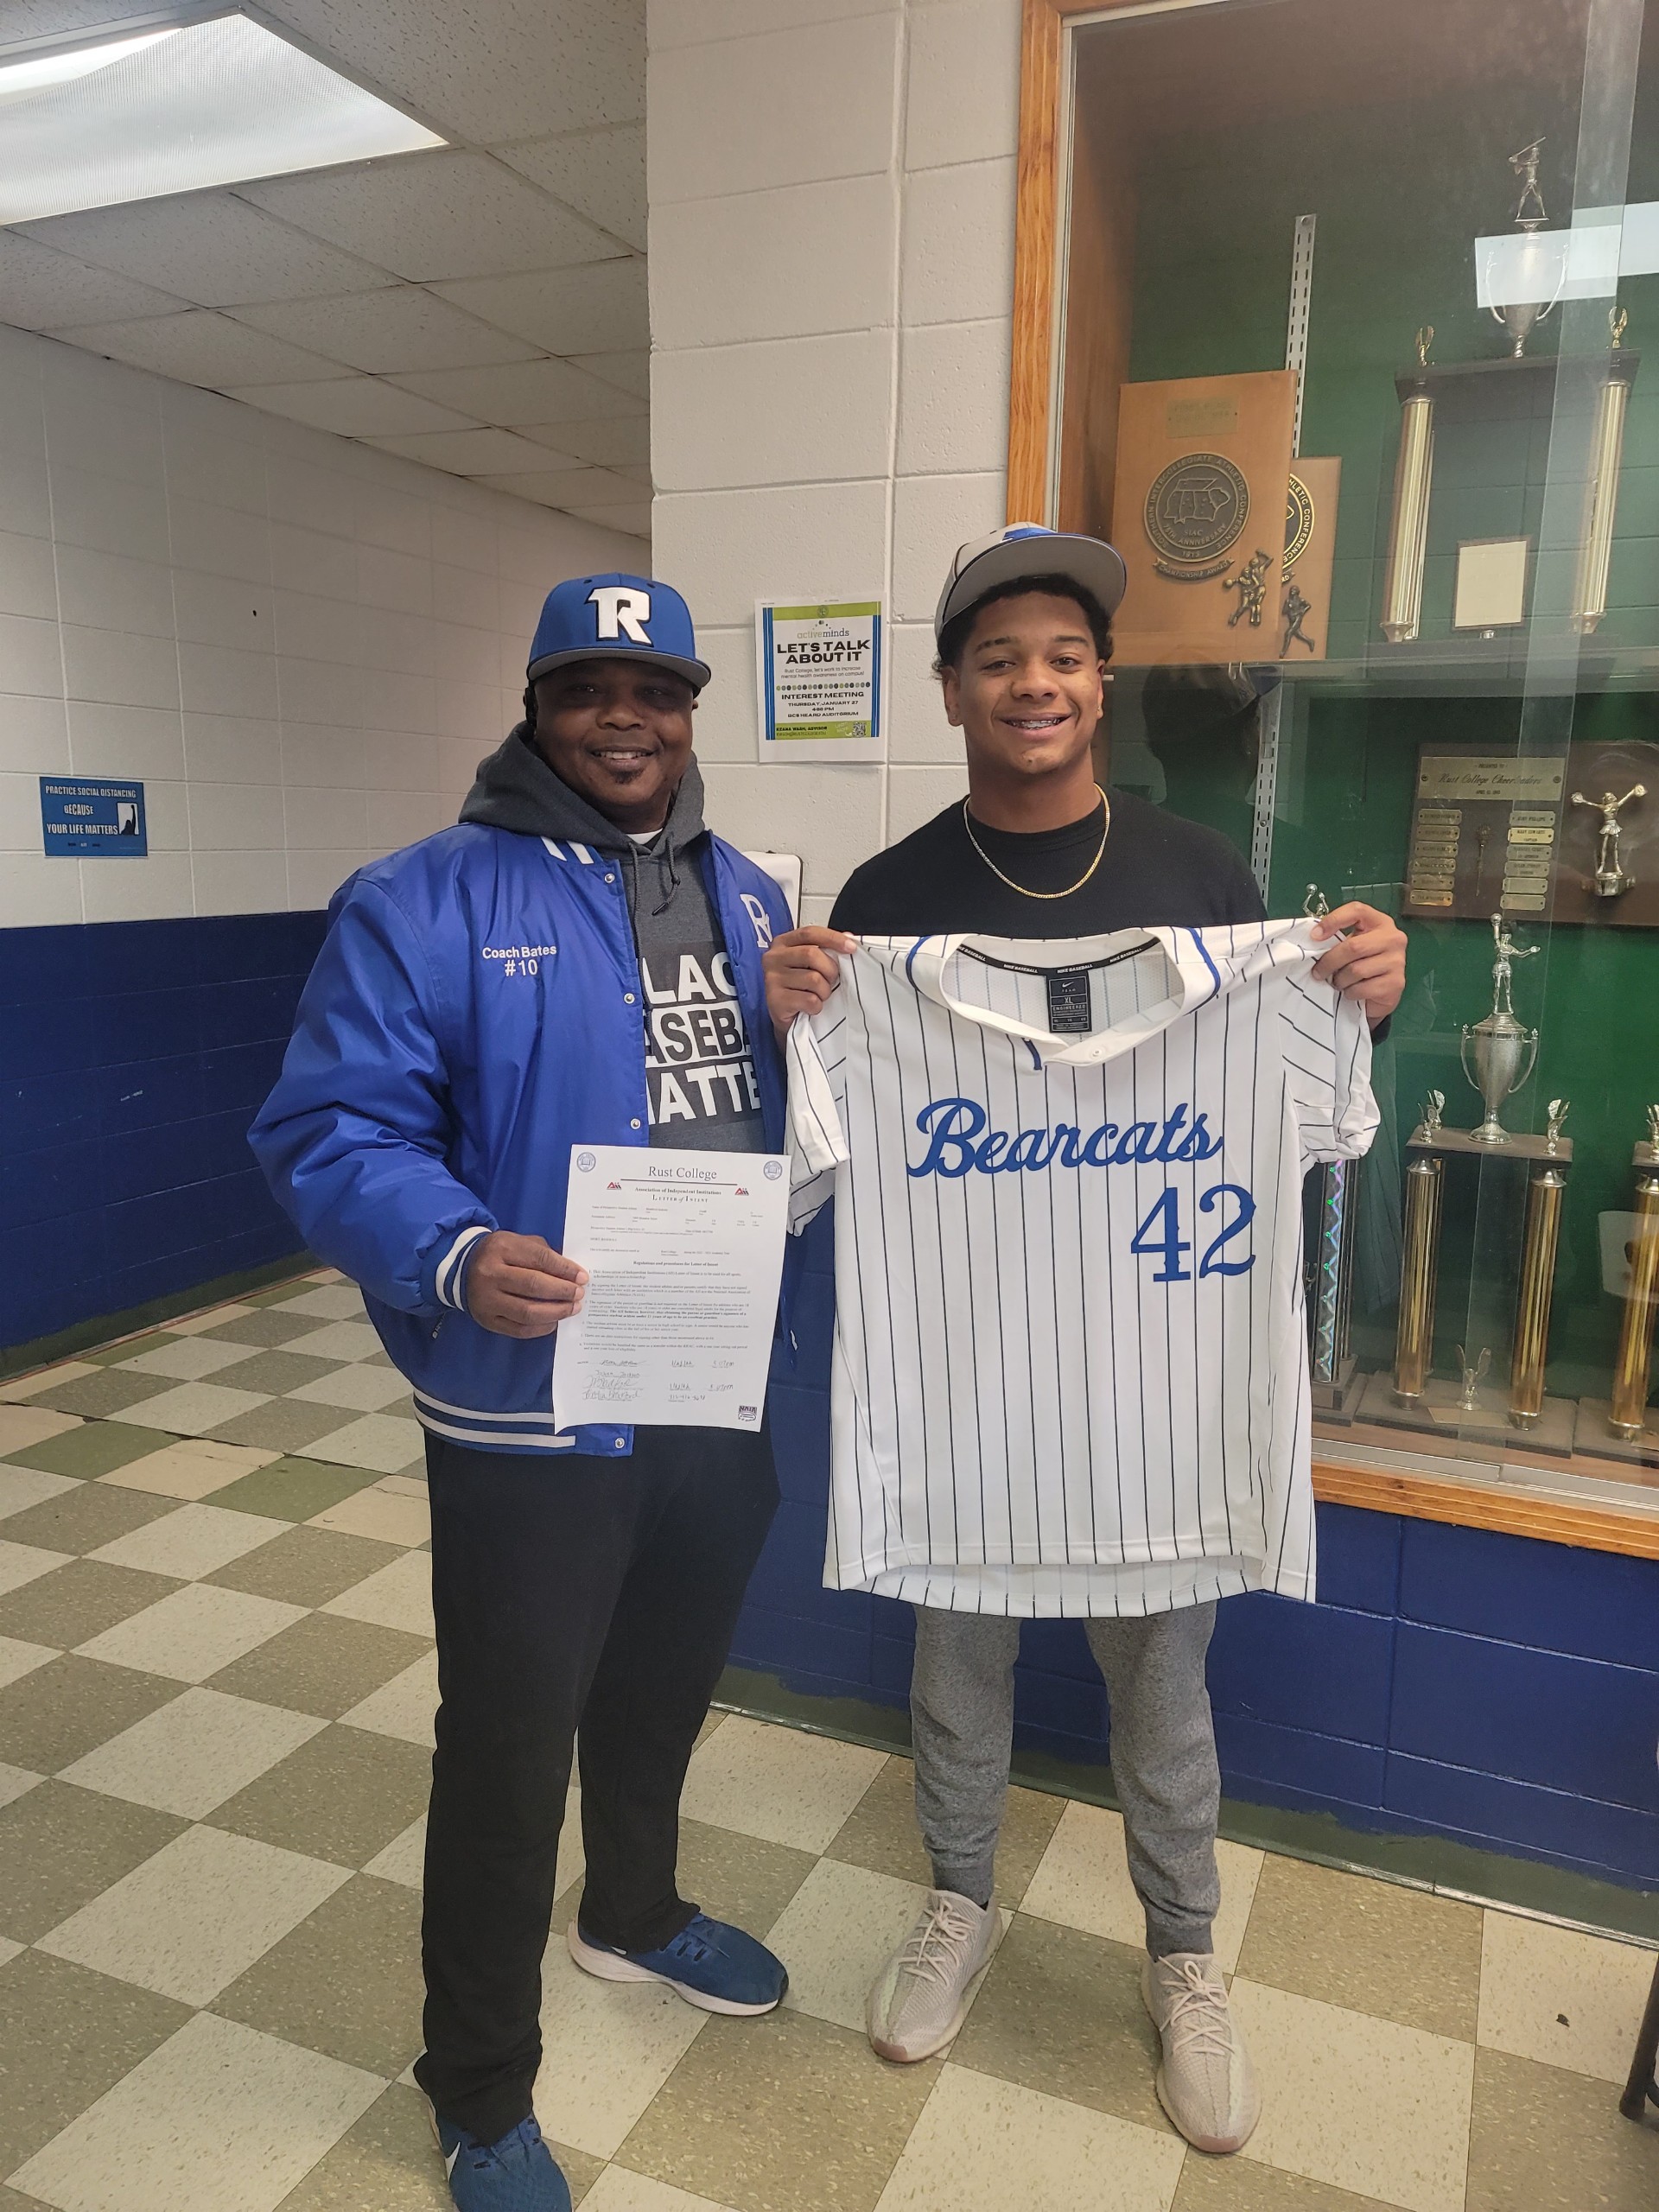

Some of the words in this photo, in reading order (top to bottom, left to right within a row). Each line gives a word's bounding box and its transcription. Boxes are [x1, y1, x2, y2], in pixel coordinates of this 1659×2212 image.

[1217, 459, 1245, 491] ATHLETIC
[1288, 478, 1308, 505] HLETIC
[1216, 494, 1247, 550] CONFERENCE
[1178, 524, 1226, 545] ANNIVERSARY
[1283, 508, 1311, 563] CONFERENCE
[1159, 564, 1204, 579] CHAMPIONSHIP
[585, 586, 654, 646] R
[777, 642, 820, 653] LET'S
[823, 639, 871, 651] TALK
[785, 652, 843, 664] ABOUT
[847, 652, 861, 661] IT
[1461, 774, 1489, 785] College
[45, 785, 77, 795] PRACTICE
[78, 787, 99, 796] SOCIAL
[100, 789, 137, 798] DISTANCING
[64, 804, 94, 816] BECAUSE
[47, 823, 68, 835] YOUR
[69, 823, 84, 835] LIFE
[85, 824, 118, 836] MATTERS
[482, 946, 520, 959] Coach
[521, 944, 557, 957] Bates
[504, 959, 538, 977] #10
[642, 951, 738, 1004] LAC
[646, 1062, 761, 1125] ATTE
[906, 1097, 1224, 1178] Bearcats
[648, 1166, 673, 1178] Rust
[677, 1167, 717, 1181] College
[1130, 1184, 1256, 1282] 42
